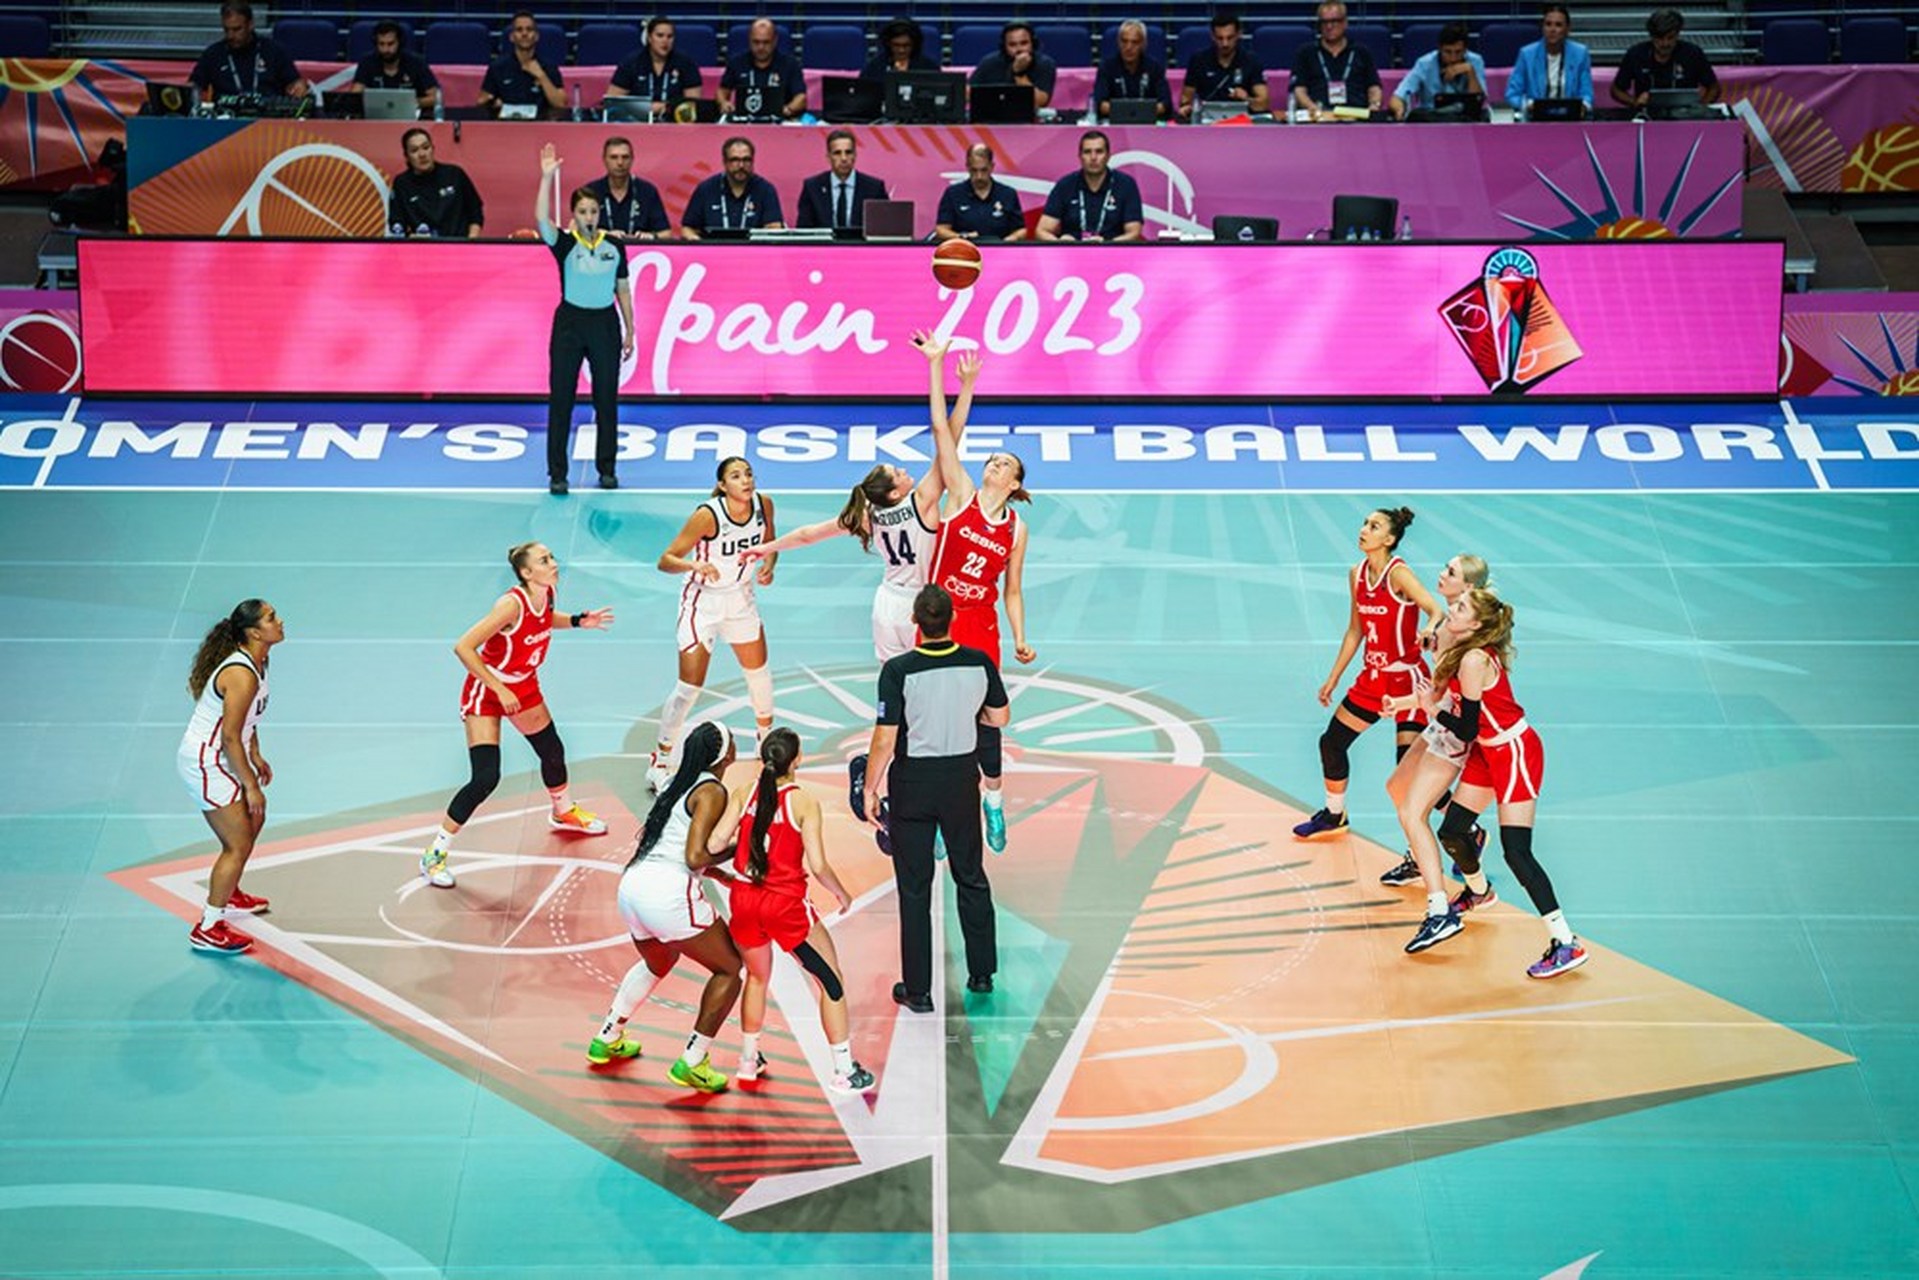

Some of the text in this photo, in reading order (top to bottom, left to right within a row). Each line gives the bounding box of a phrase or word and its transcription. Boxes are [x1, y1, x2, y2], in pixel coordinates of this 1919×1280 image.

[581, 250, 1145, 395] Spain 2023
[0, 419, 1919, 462] OMEN'S BASKETBALL WORLD
[881, 530, 916, 566] 14
[960, 551, 988, 579] 22
